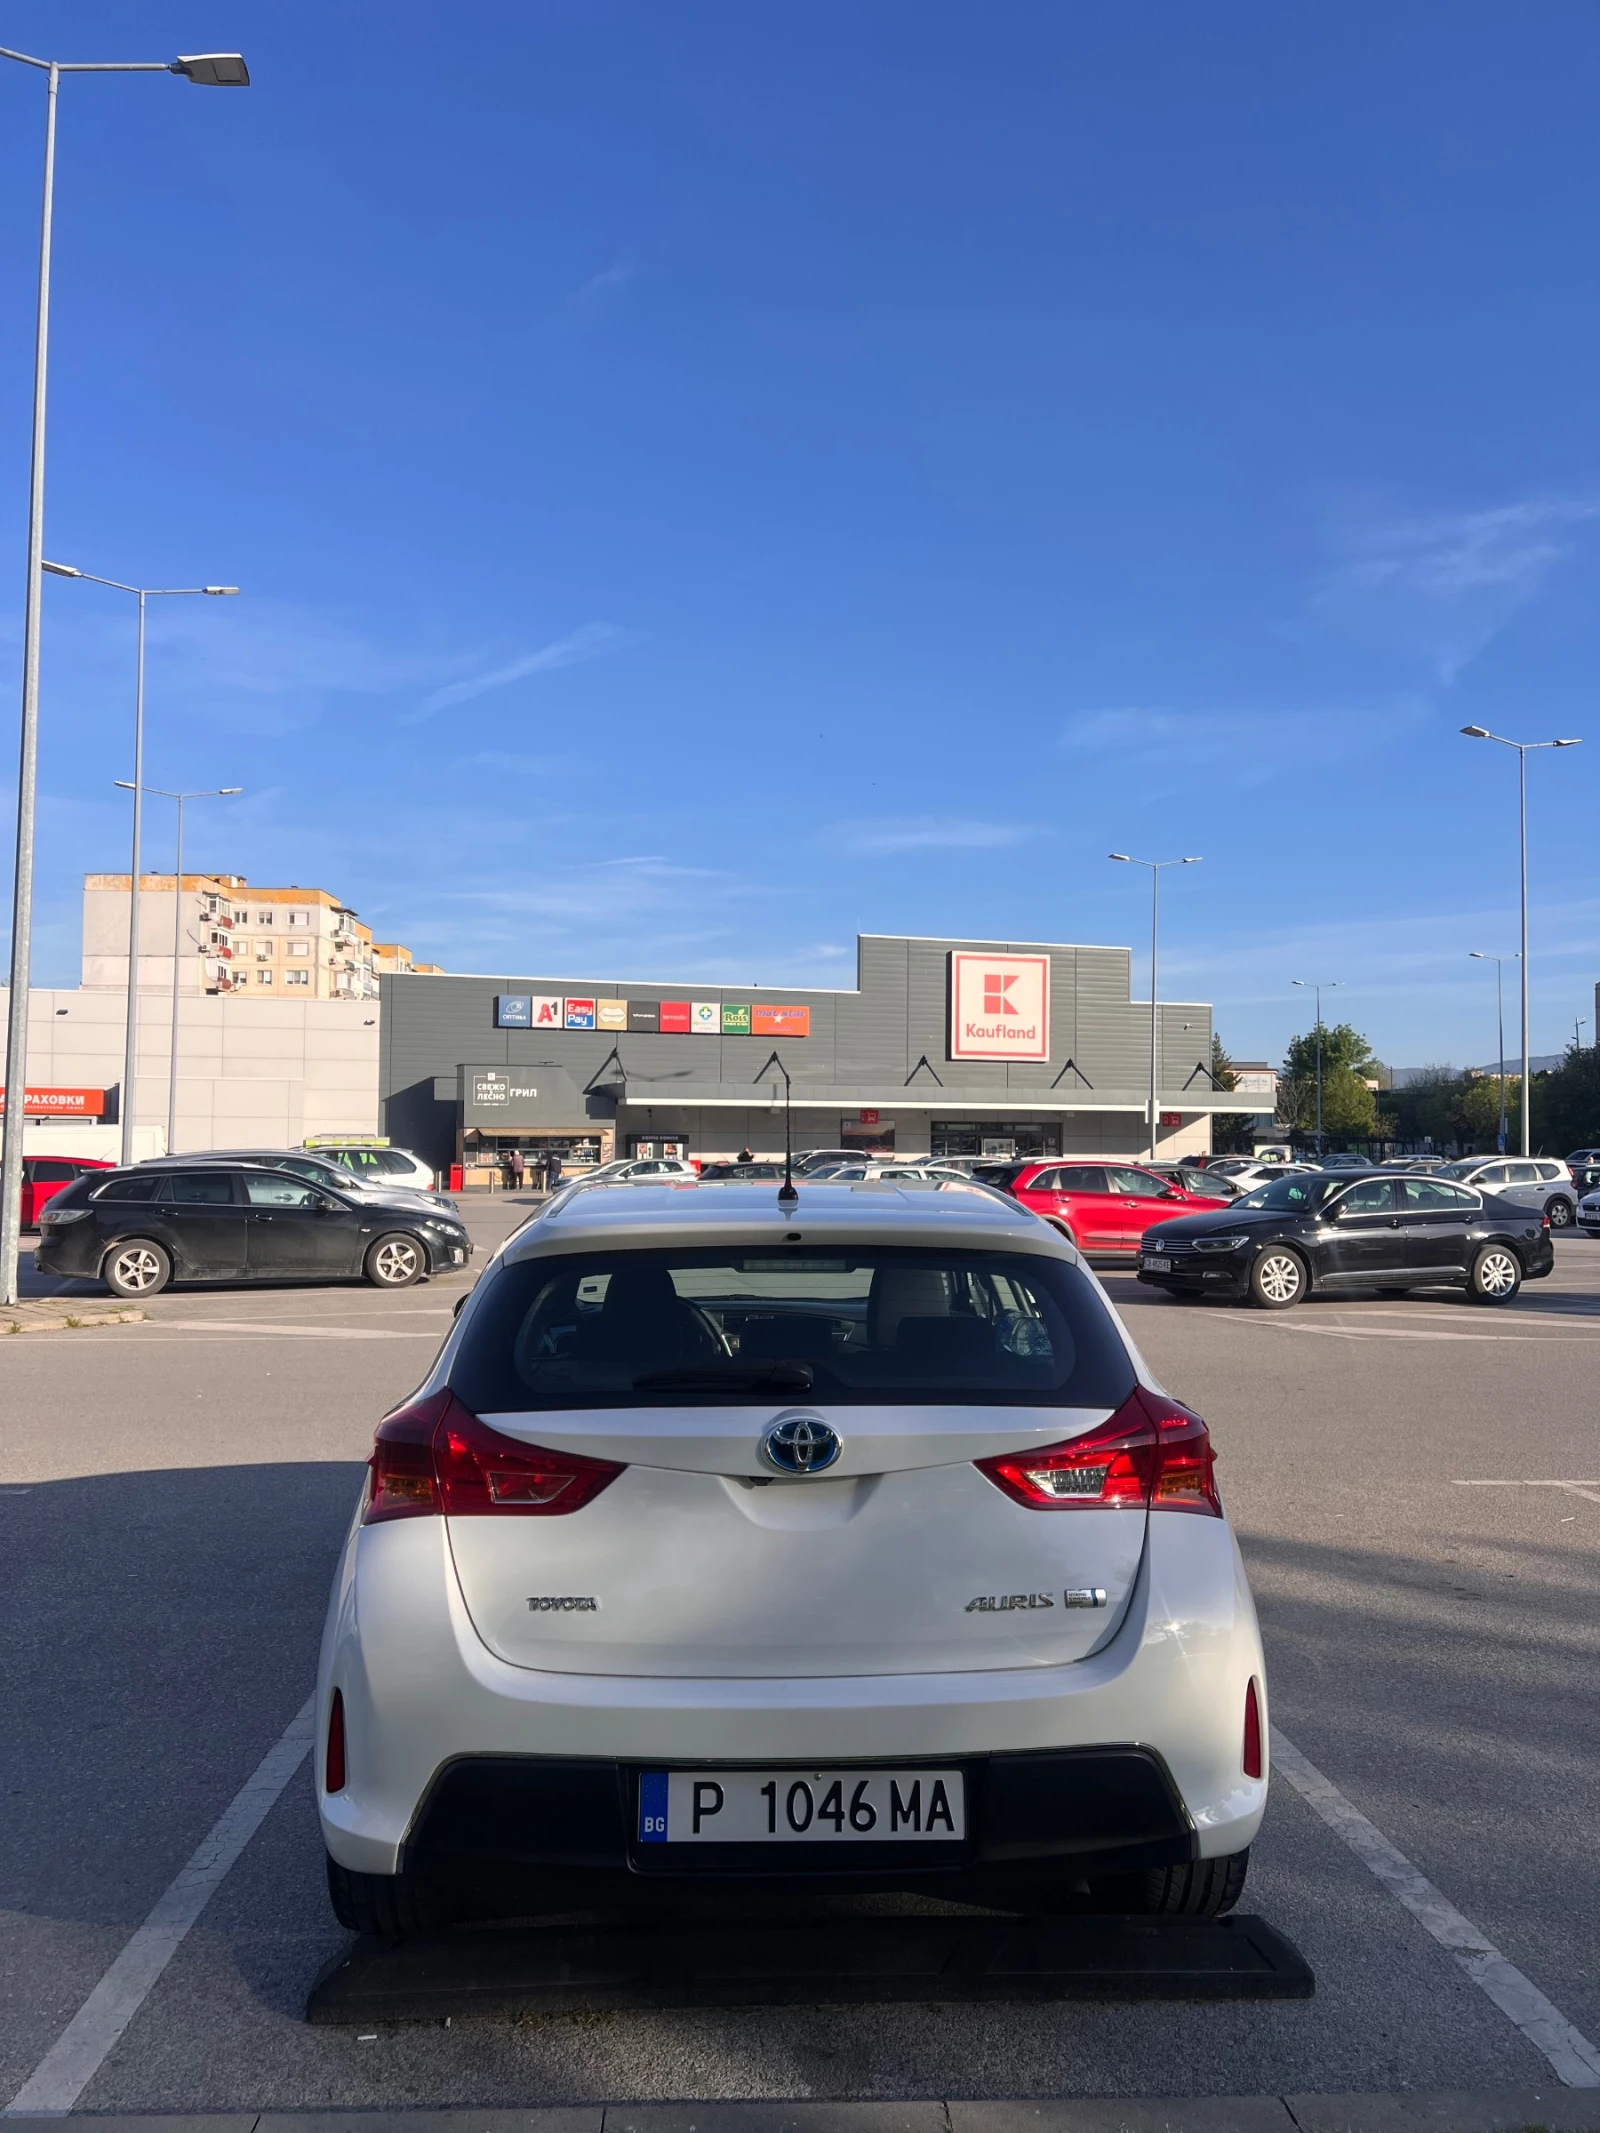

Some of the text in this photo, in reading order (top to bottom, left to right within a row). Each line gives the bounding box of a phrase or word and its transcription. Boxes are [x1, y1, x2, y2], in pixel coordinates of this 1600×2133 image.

[537, 1001, 558, 1023] A1
[567, 1003, 593, 1016] Easy
[567, 1014, 587, 1025] Pay
[725, 1012, 748, 1022] Rois
[966, 1023, 1036, 1039] Kaufland
[476, 1083, 506, 1091] СВЕЖО
[509, 1088, 537, 1098] ГРИЛ
[476, 1093, 506, 1101] ЛЕСНО
[526, 1596, 598, 1612] TOYOTA
[964, 1592, 1055, 1613] AURIS
[692, 1779, 956, 1834] P 1046 MA
[643, 1816, 666, 1833] BG
